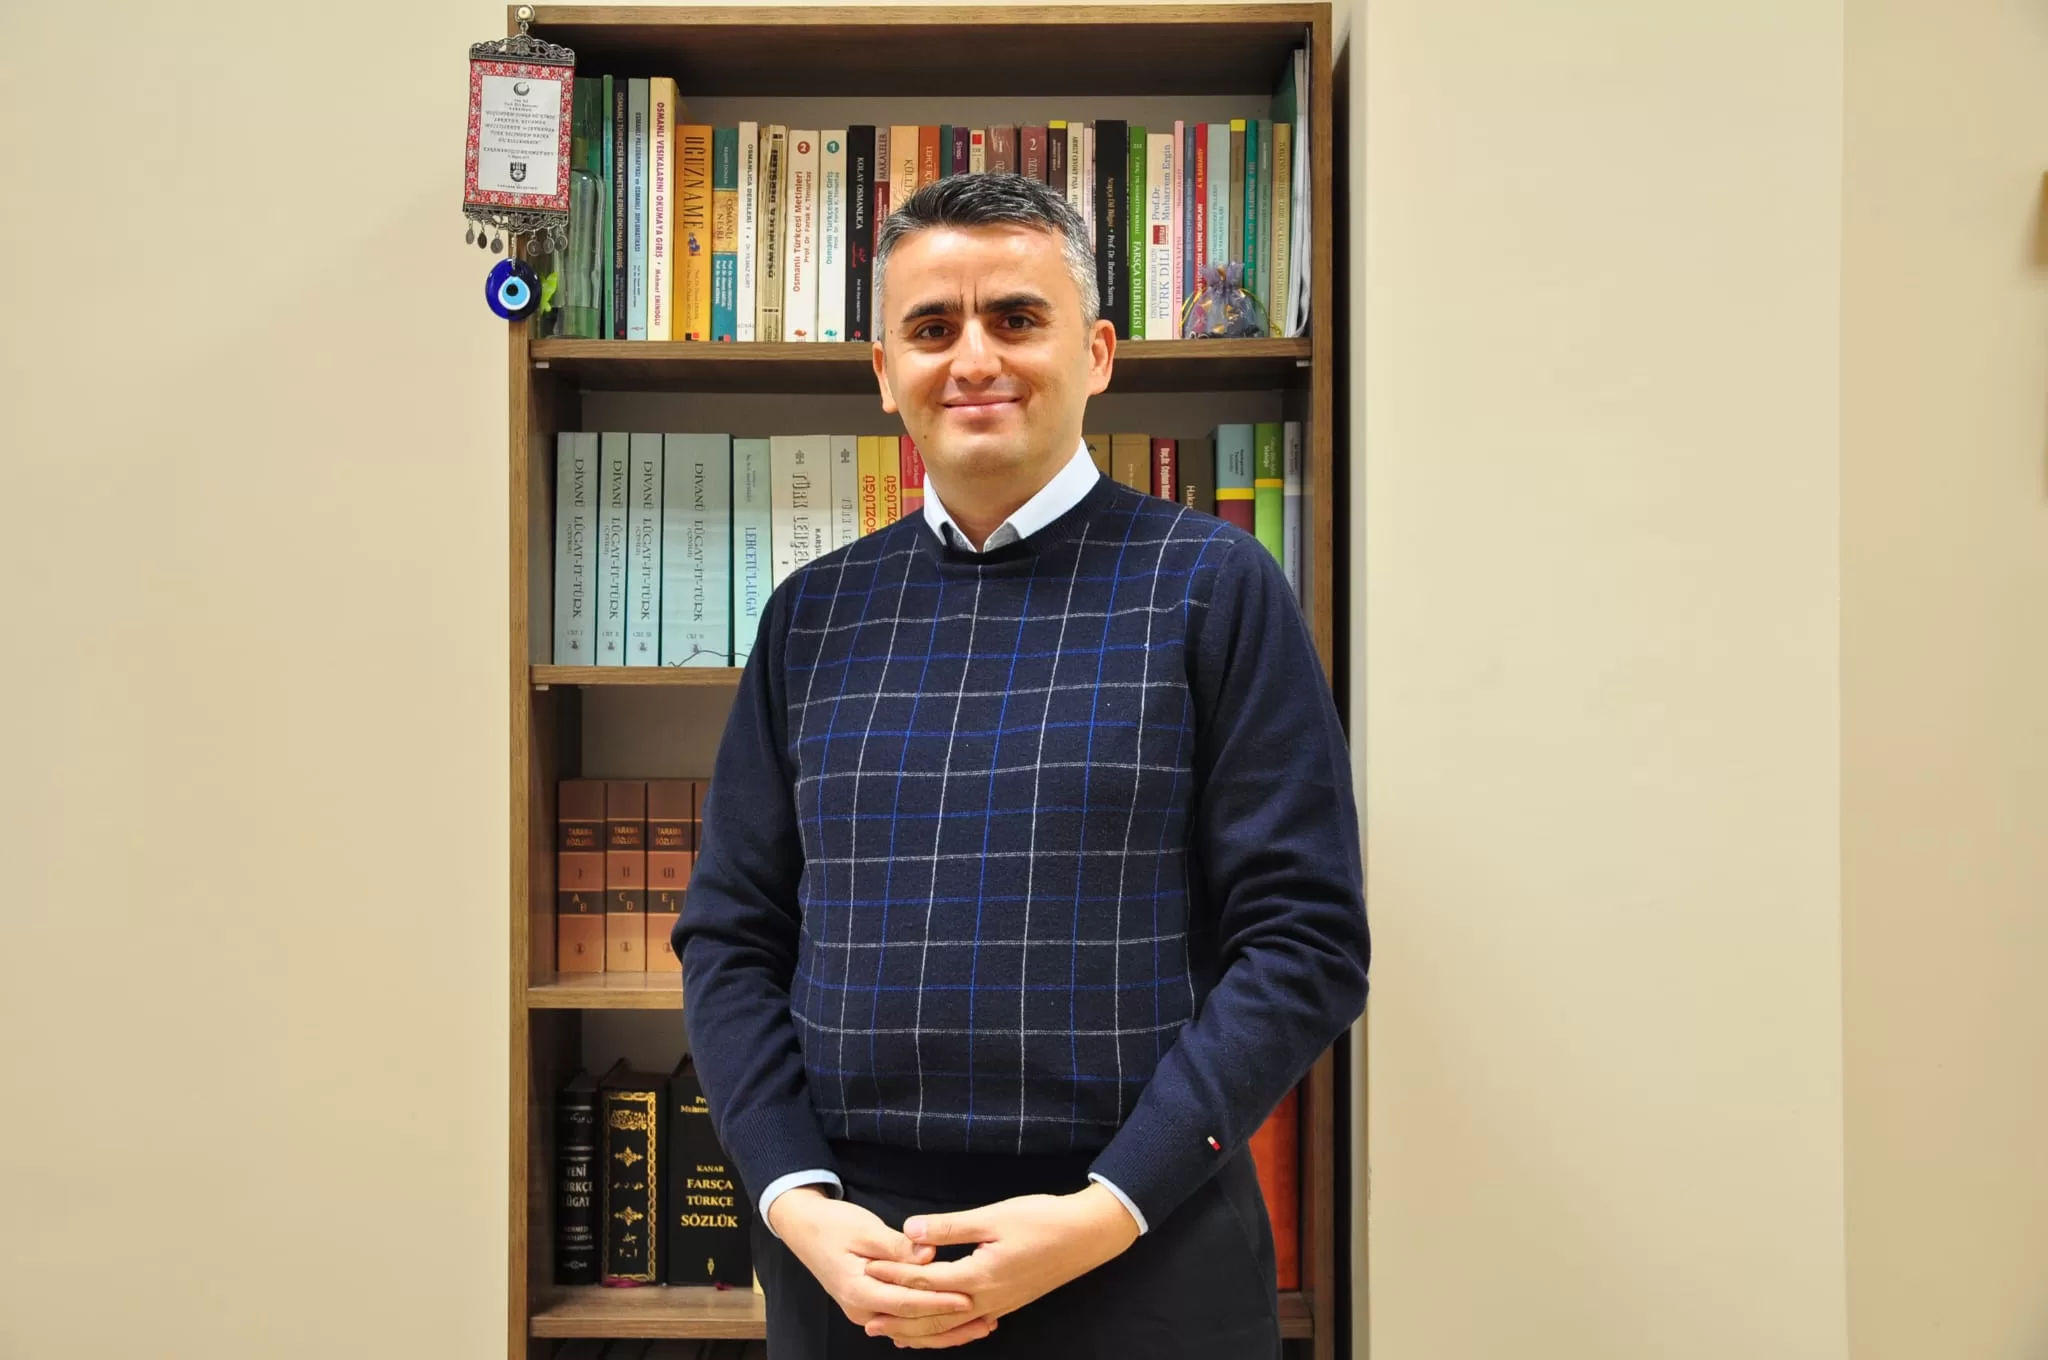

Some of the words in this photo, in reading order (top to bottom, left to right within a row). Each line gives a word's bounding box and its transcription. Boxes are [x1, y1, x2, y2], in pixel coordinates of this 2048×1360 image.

[655, 102, 665, 138] OSMANLI
[1029, 137, 1037, 151] 2
[1162, 144, 1172, 170] Ergin
[856, 156, 865, 184] KOLAY
[794, 171, 803, 213] Metinleri
[855, 184, 864, 230] OSMANLICA
[1161, 172, 1171, 221] Muharrem
[655, 195, 664, 235] OKUMAYA
[725, 198, 734, 240] OSMANLI
[793, 215, 802, 253] Türkçesi
[792, 256, 801, 292] Osmanlı
[1131, 240, 1142, 277] FARSÇA
[1157, 248, 1170, 277] DİLİ
[1132, 278, 1143, 329] DİLBİLGİSİ
[1158, 281, 1170, 319] TÜRK
[574, 458, 587, 508] DİVANÜ
[611, 459, 624, 509] DİVANÜ
[642, 460, 655, 510] DİVANÜ
[694, 463, 706, 511] DİVANÜ
[792, 471, 811, 509] TÜRK
[884, 475, 897, 526] ÖZLÜĞÜ
[686, 1178, 734, 1191] FARSÇA
[696, 1164, 724, 1173] KANAR
[680, 1212, 738, 1228] SÖZLÜK
[685, 1194, 734, 1209] TÜRKÇE
